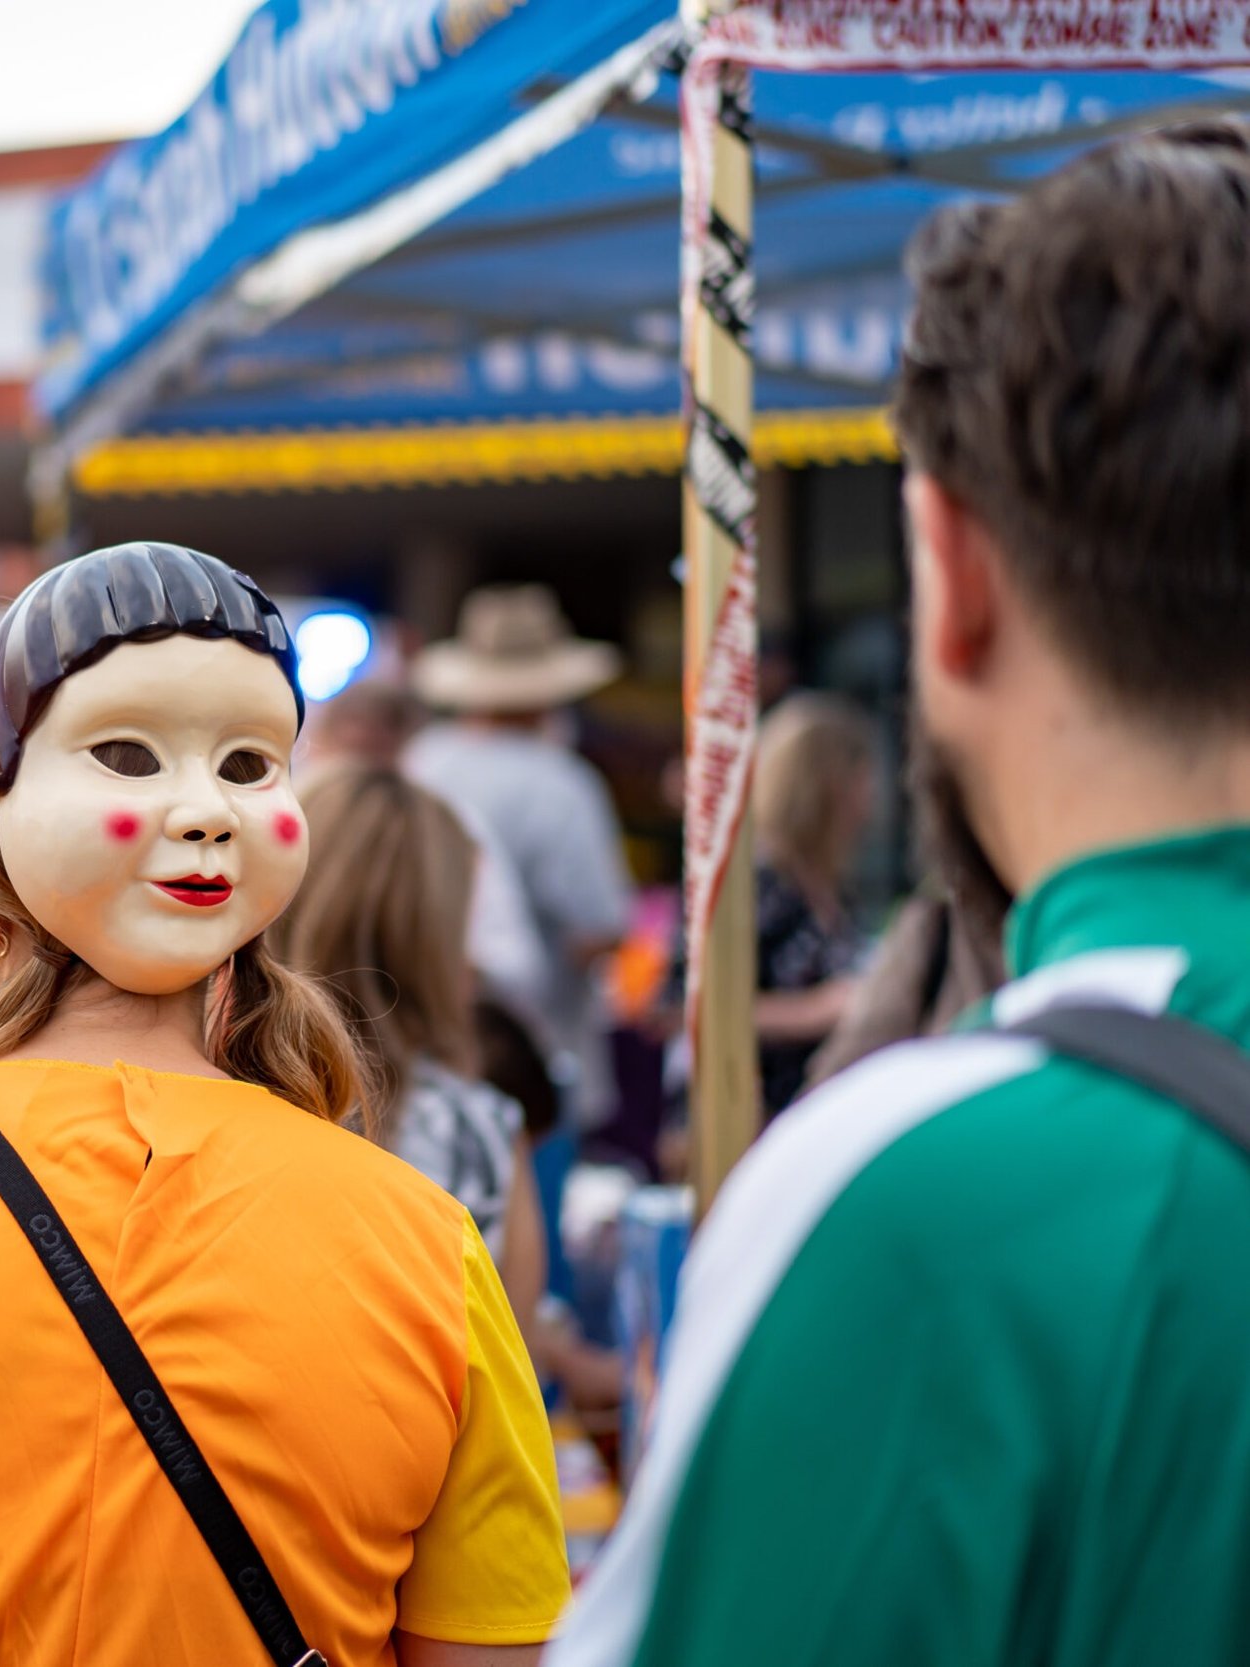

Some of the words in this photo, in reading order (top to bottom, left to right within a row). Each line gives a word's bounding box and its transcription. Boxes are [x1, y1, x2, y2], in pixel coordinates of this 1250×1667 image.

[871, 12, 1002, 50] CAUTION
[1022, 13, 1134, 50] ZOMBIE
[1144, 13, 1220, 50] ZONE
